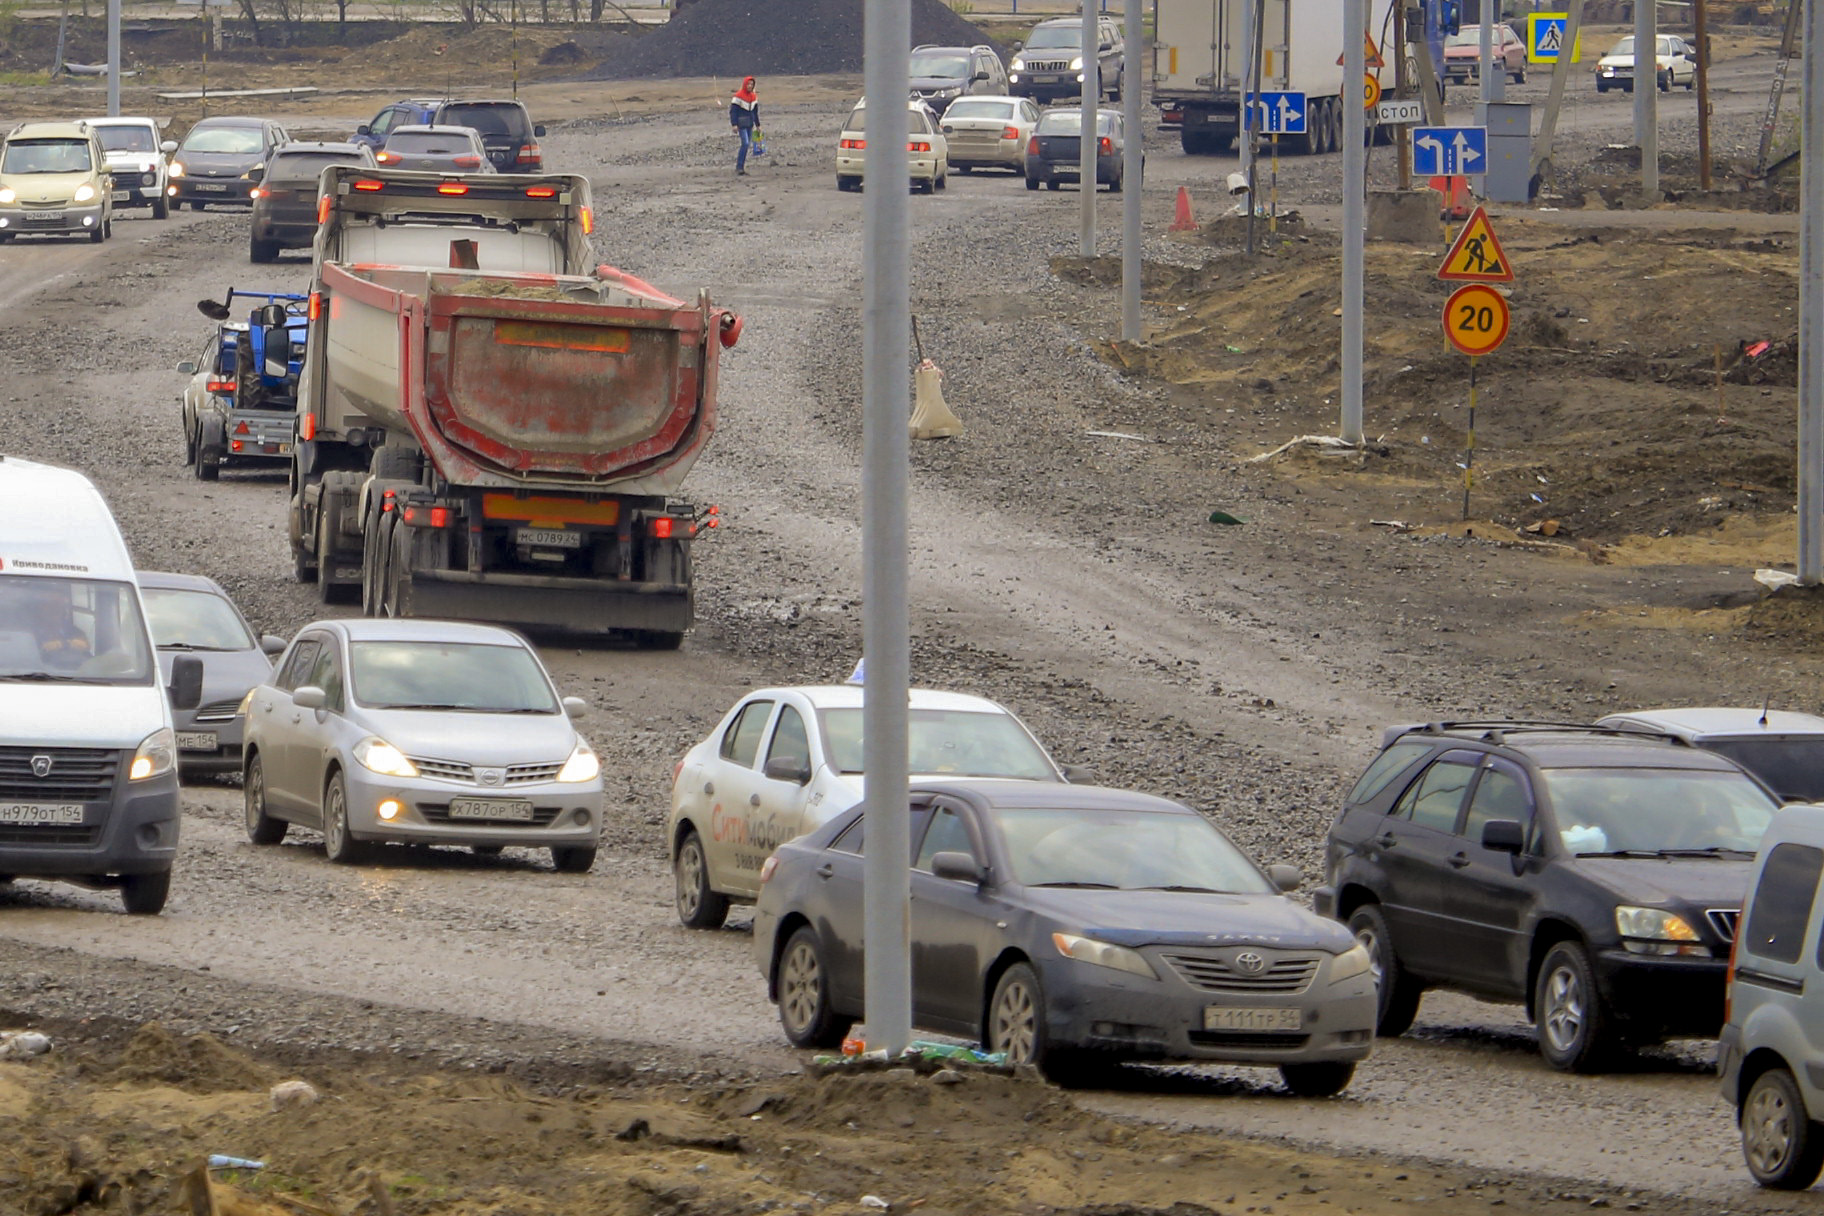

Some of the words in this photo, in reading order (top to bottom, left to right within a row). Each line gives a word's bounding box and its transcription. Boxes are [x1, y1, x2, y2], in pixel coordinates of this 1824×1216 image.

[1381, 106, 1419, 119] СТОП
[1459, 305, 1493, 333] 20
[12, 559, 89, 573] Криводановка
[60, 805, 80, 817] 154
